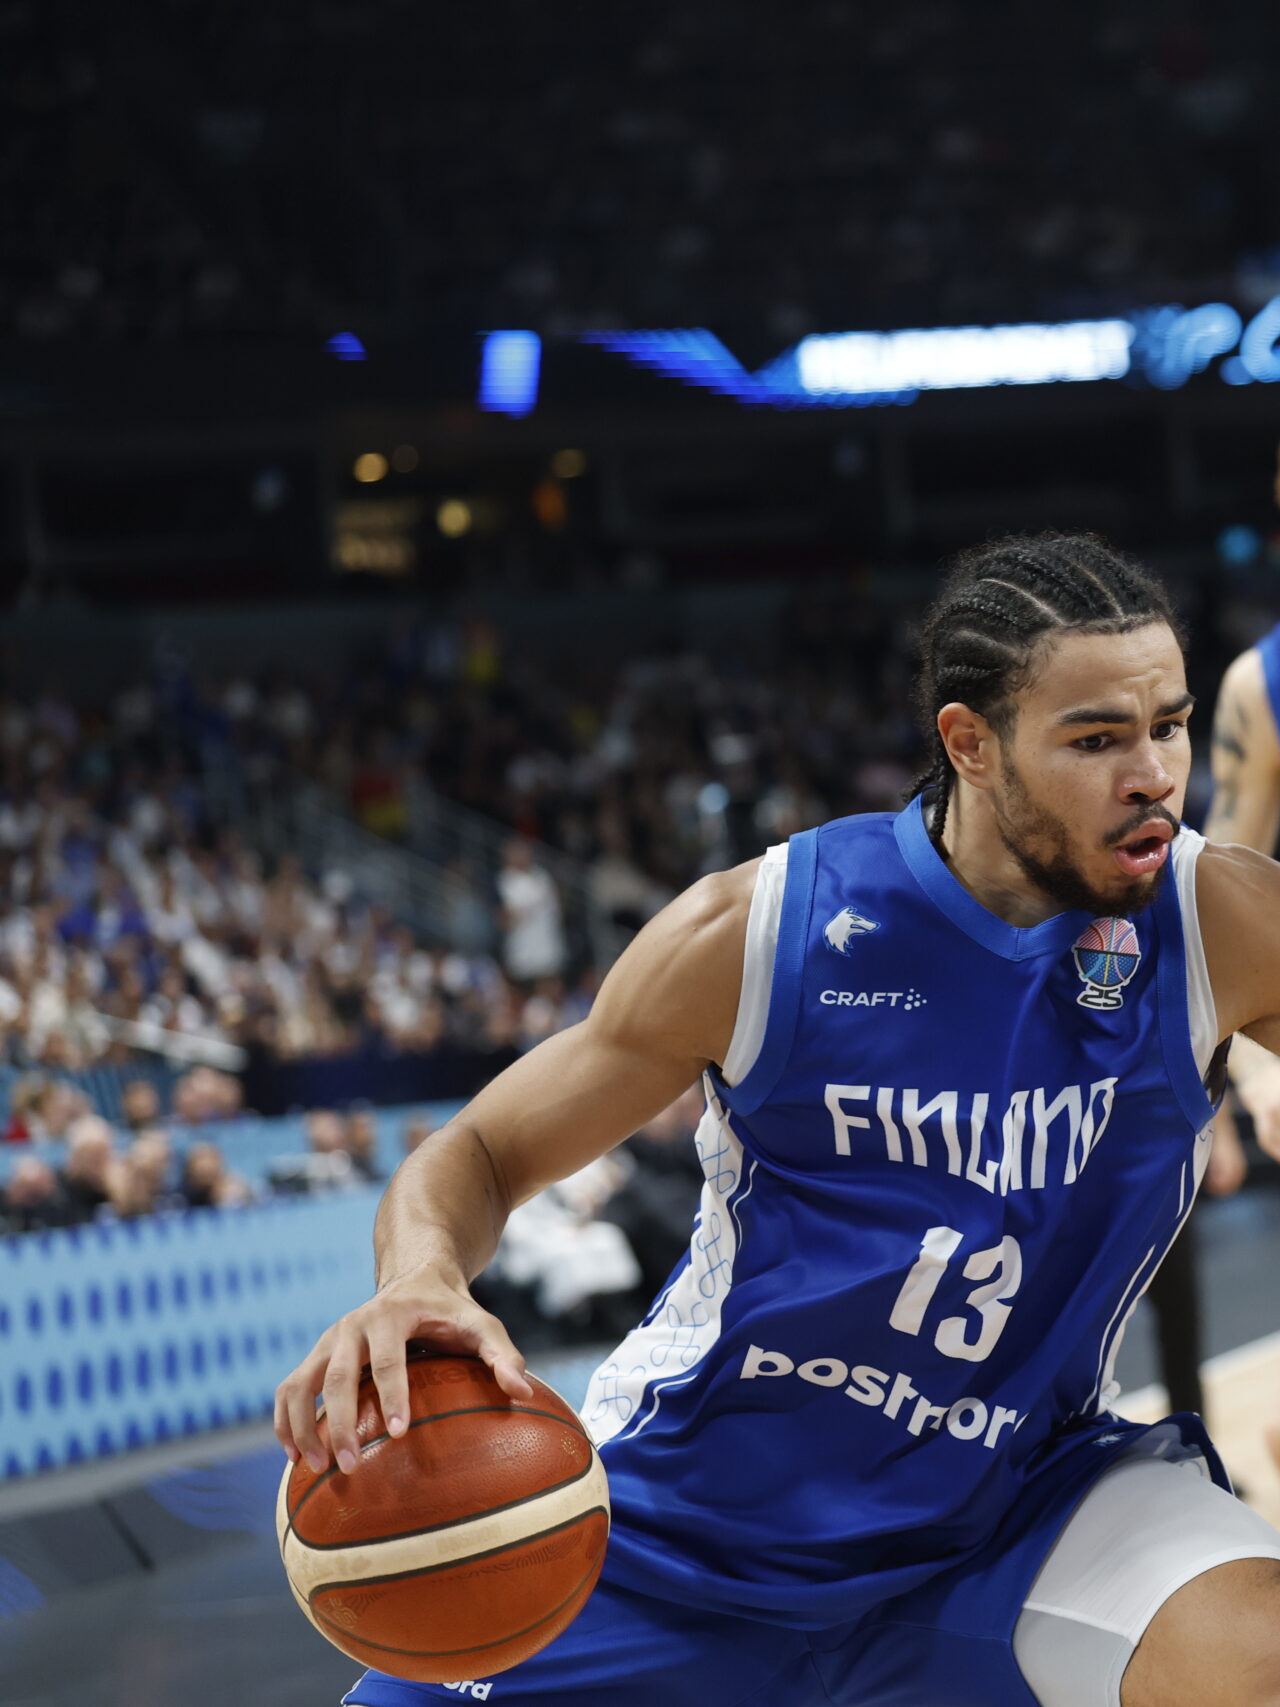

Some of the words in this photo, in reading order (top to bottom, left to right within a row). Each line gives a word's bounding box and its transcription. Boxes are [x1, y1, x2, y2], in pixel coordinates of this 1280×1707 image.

[820, 989, 904, 1007] CRAFT
[1079, 986, 1123, 1008] 25
[824, 1077, 1119, 1197] FINLAND
[888, 1225, 1023, 1363] 13
